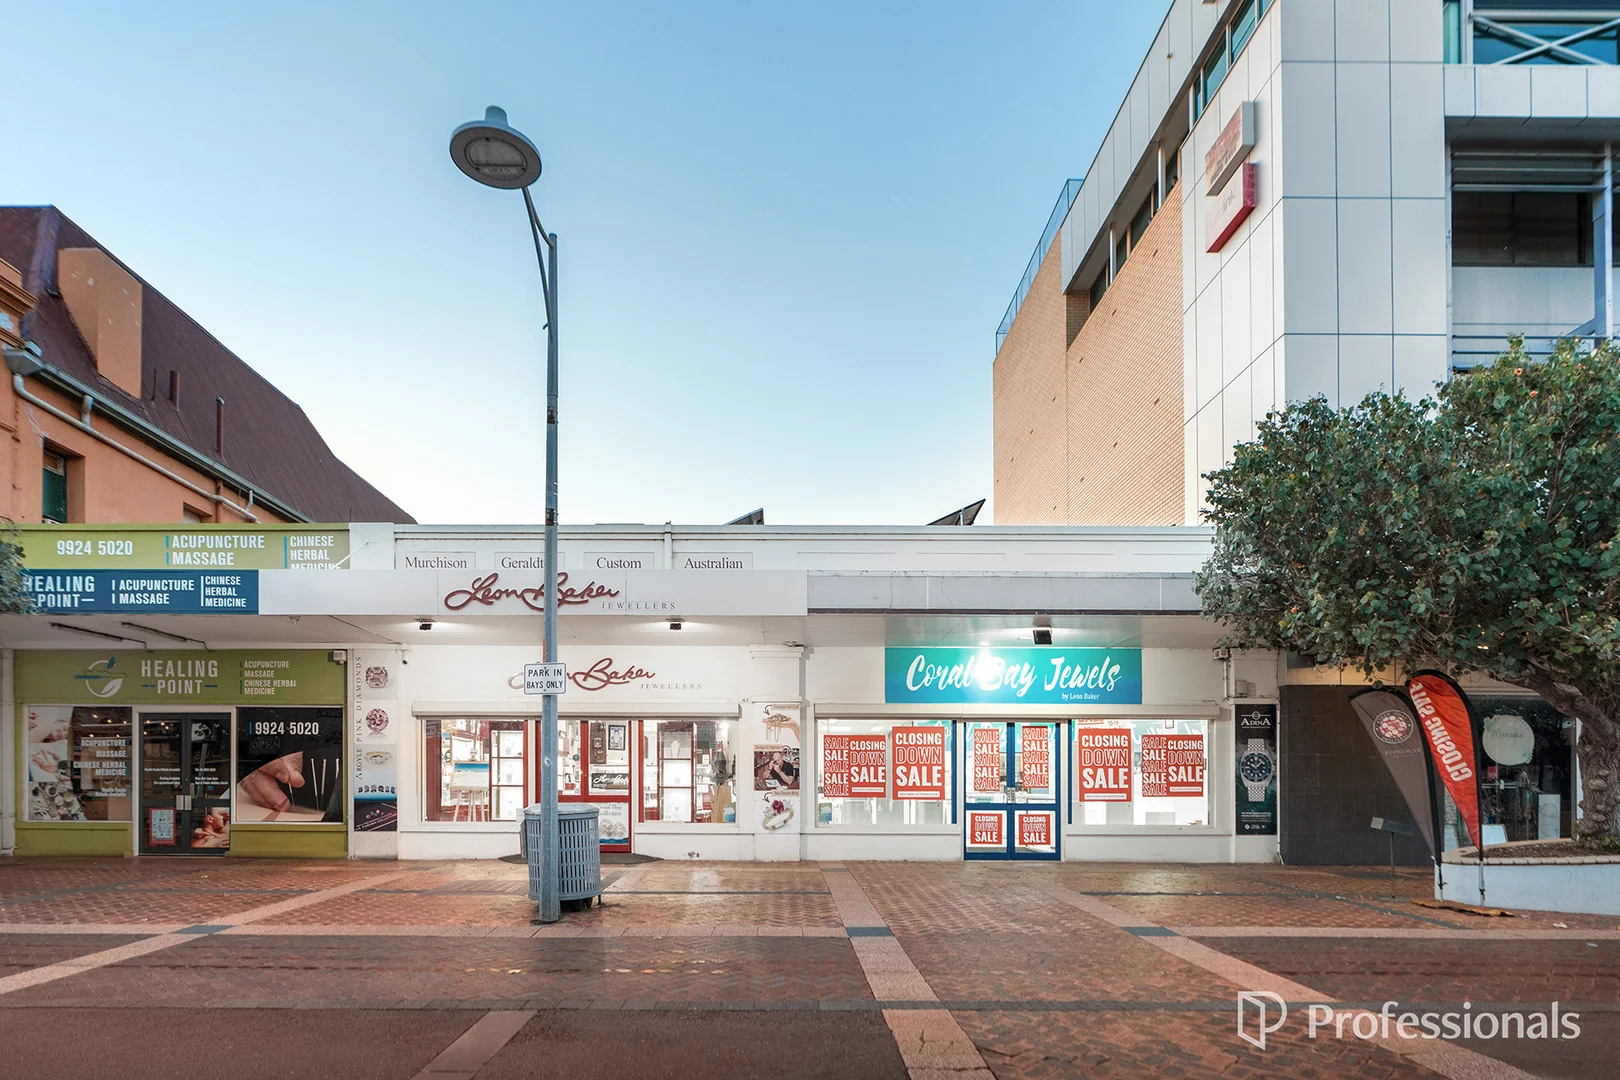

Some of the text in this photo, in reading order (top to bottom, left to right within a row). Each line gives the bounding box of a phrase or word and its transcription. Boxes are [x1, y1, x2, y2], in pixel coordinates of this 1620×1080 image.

[172, 535, 265, 549] ACUPUNCTURE
[290, 535, 334, 546] CHINESE
[57, 540, 133, 555] 9924 5020
[172, 552, 234, 565] MASSAGE
[290, 549, 330, 560] HERBAL
[405, 556, 467, 569] Murchison
[501, 556, 545, 569] Geraldt
[596, 557, 642, 569] Custom
[684, 557, 743, 569] Australian
[24, 576, 95, 592] HEALING
[119, 580, 195, 590] ACUPUNCTURE
[205, 576, 241, 585] CHINESE
[205, 587, 237, 596] HERBAL
[444, 571, 620, 612] Leon Baker
[37, 594, 80, 607] POINT
[119, 593, 169, 604] MASSAGE
[205, 598, 247, 607] MEDICINE
[601, 602, 676, 610] JEWELLERS
[141, 660, 218, 678] HEALING
[244, 670, 275, 678] MASSAGE
[528, 669, 562, 677] PARK IN
[570, 657, 656, 691] Baker
[906, 654, 1122, 698] Coral Bay Jewels
[157, 680, 203, 694] POINT
[526, 680, 564, 689] BAYS ONLY
[244, 687, 275, 695] MEDICINE
[1061, 692, 1101, 700] by Leon Baker
[1240, 717, 1271, 725] ADINA
[255, 722, 319, 735] 9924 5020
[1023, 728, 1048, 740] SALE
[81, 739, 126, 747] ACUPUNCTURE
[895, 733, 942, 745] CLOSING
[974, 731, 999, 743] SALE
[1082, 735, 1128, 747] CLOSING
[1142, 737, 1167, 749] SALE
[824, 738, 849, 749] SALE
[850, 741, 886, 750] CLOSING
[974, 743, 999, 755] SALE
[1023, 740, 1048, 751] SALE
[1167, 740, 1203, 750] CLOSING
[95, 750, 126, 758] MASSAGE
[824, 750, 849, 761] SALE
[850, 752, 886, 765] DOWN
[895, 746, 942, 764] DOWN
[1023, 752, 1048, 763] SALE
[1081, 749, 1128, 766] DOWN
[1142, 749, 1167, 760] SALE
[1167, 751, 1204, 765] DOWN
[73, 761, 126, 769] CHINESE HERBAL
[824, 761, 849, 772] SALE
[974, 755, 999, 766] SALE
[1142, 760, 1167, 772] SALE
[850, 766, 886, 782] SALE
[974, 766, 999, 778] SALE
[1023, 763, 1048, 775] SALE
[1168, 766, 1204, 782] SALE
[824, 773, 849, 784] SALE
[896, 765, 943, 786] SALE
[1023, 775, 1048, 787] SALE
[1082, 768, 1129, 788] SALE
[1142, 772, 1167, 784] SALE
[974, 778, 999, 790] SALE
[1142, 784, 1167, 796] SALE
[824, 785, 849, 796] SALE
[975, 823, 998, 831] DOWN
[1023, 823, 1046, 832] DOWN
[975, 832, 998, 842] SALE
[1023, 833, 1046, 843] SALE
